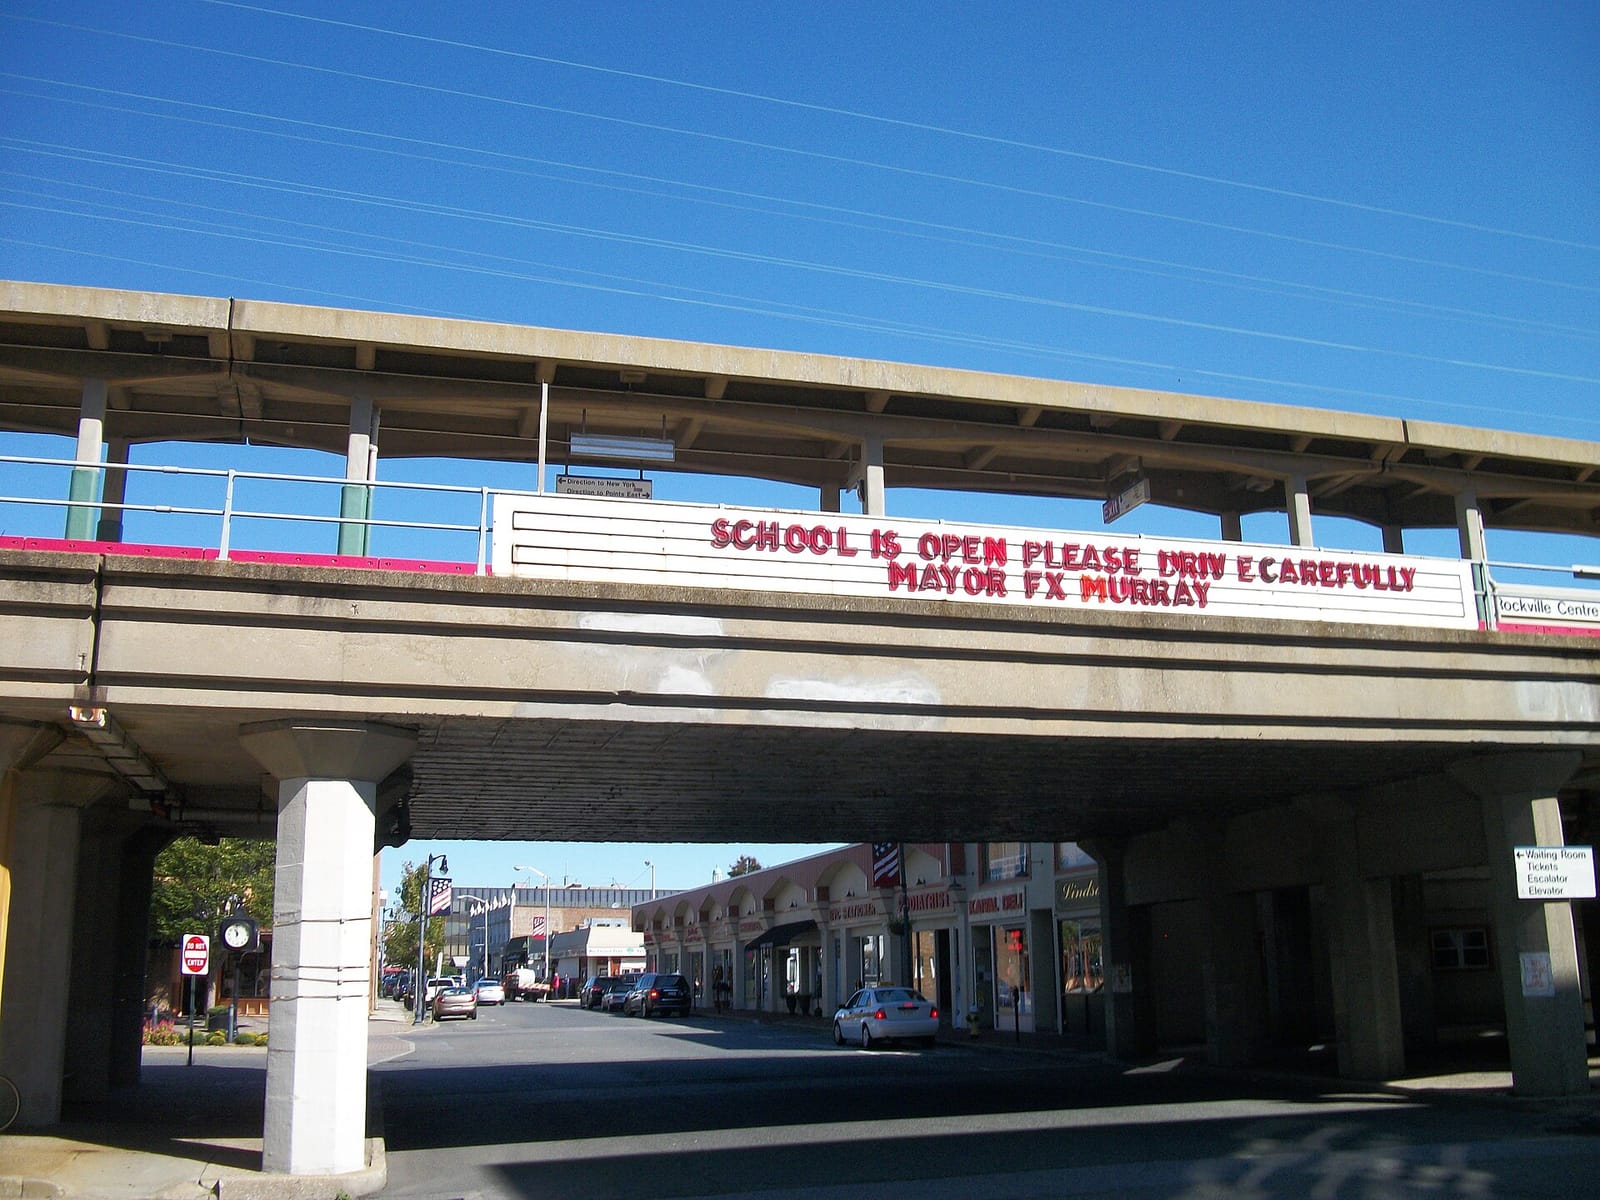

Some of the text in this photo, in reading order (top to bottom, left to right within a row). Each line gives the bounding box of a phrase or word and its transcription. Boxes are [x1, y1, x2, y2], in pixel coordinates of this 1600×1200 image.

[567, 478, 596, 486] Direction
[605, 490, 625, 498] Points
[710, 517, 859, 557] SCHOOL
[870, 528, 902, 560] IS
[917, 532, 1008, 567] OPEN
[1022, 540, 1141, 575] PLEASE
[887, 560, 1212, 609] MAYOR FX MURRAY
[1557, 601, 1599, 617] Centre
[1526, 850, 1587, 860] Waiting Room
[1528, 862, 1559, 871] Tickets
[1528, 874, 1568, 883] Escalator
[1528, 886, 1564, 895] Elevator
